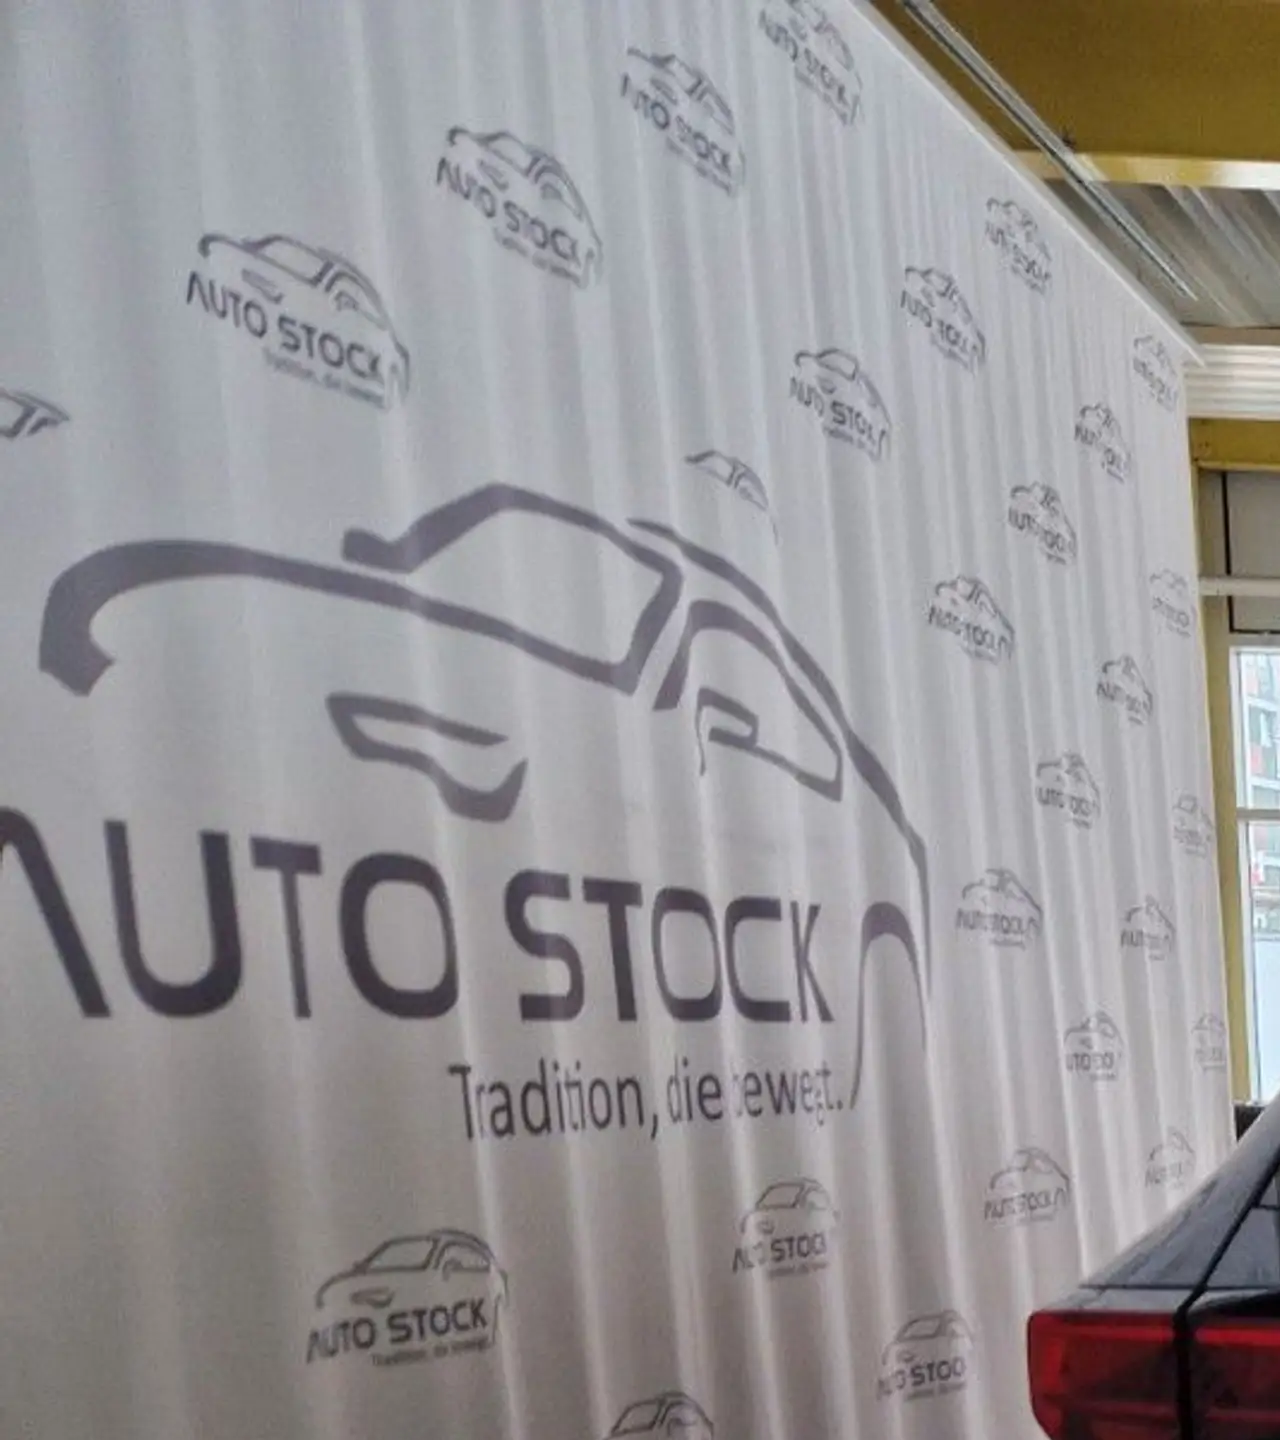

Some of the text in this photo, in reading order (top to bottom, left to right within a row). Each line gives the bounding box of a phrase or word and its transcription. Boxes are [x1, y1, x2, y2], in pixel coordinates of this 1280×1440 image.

[187, 271, 267, 339] AUTO
[505, 868, 834, 1023] STOCK
[448, 1056, 658, 1141] Tradition,
[666, 1058, 723, 1126] die
[307, 1316, 376, 1365] AUTO
[387, 1298, 489, 1346] STOCK
